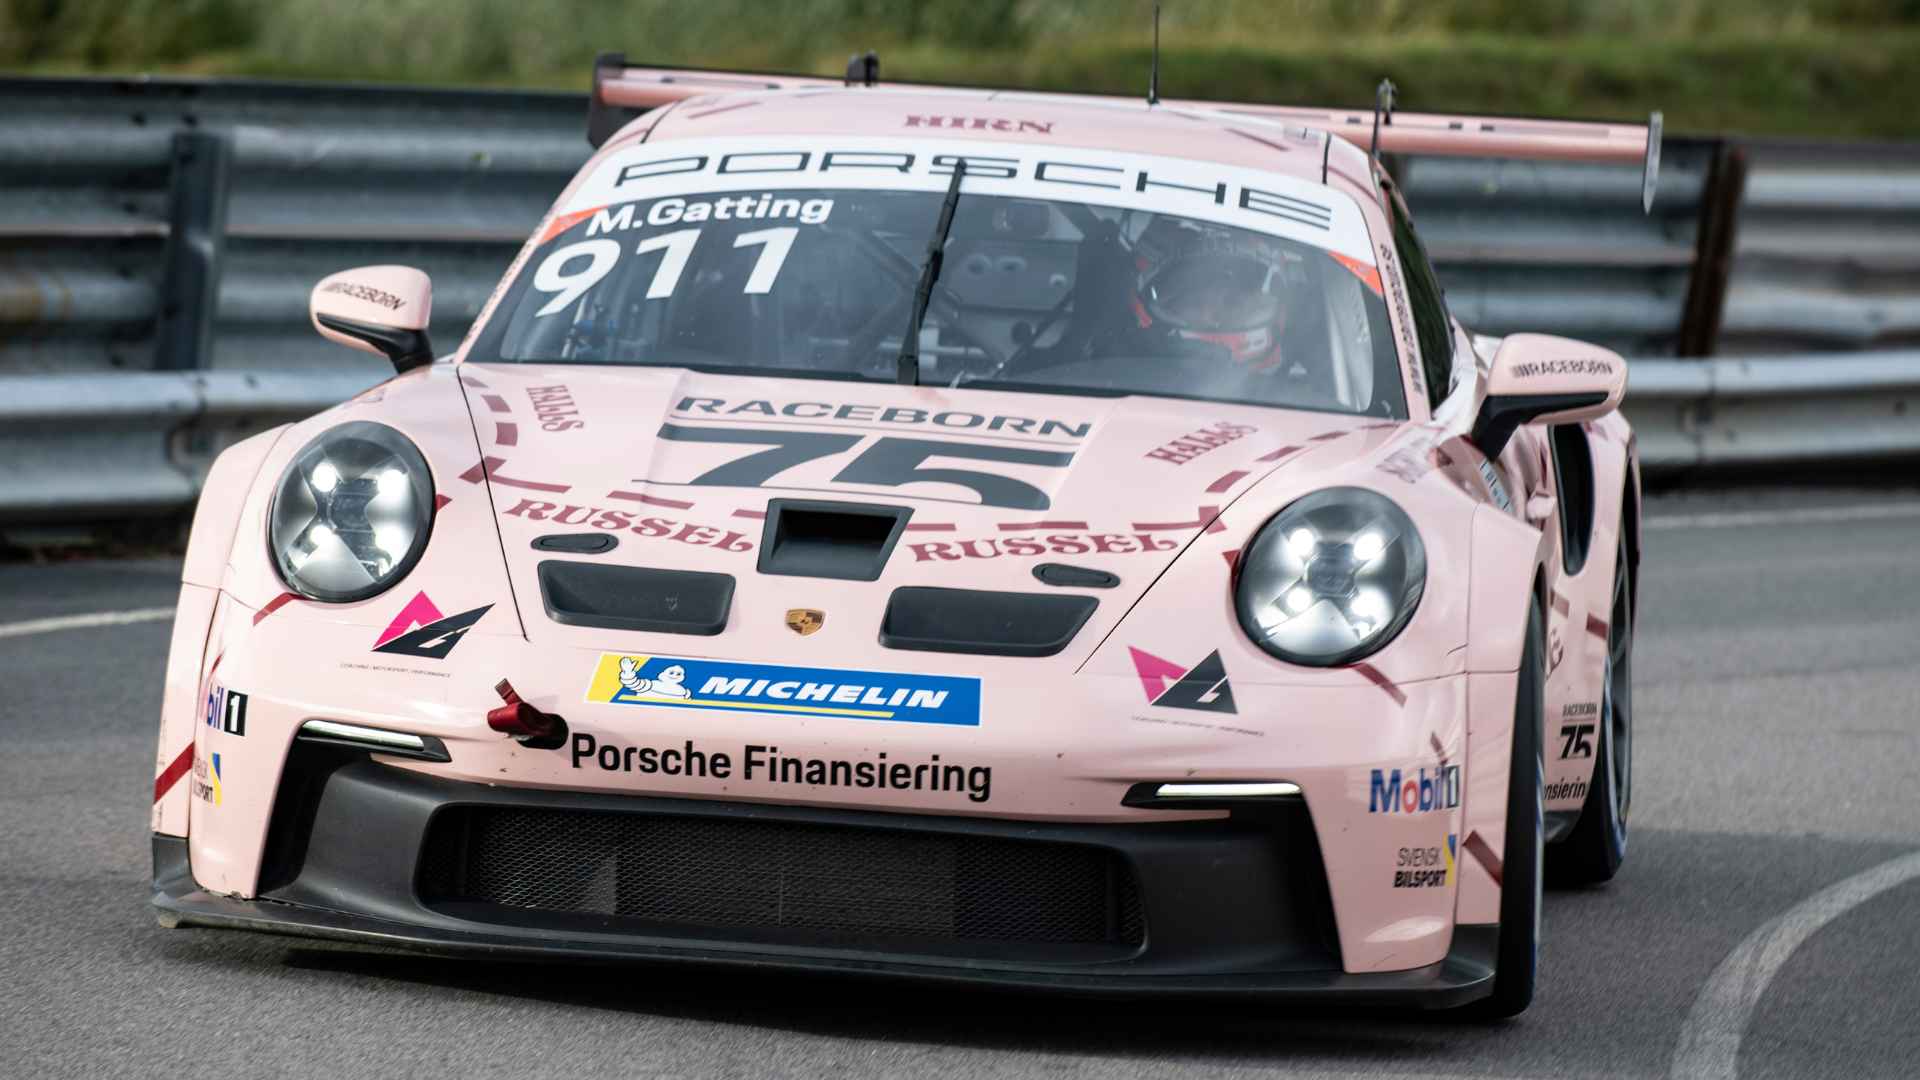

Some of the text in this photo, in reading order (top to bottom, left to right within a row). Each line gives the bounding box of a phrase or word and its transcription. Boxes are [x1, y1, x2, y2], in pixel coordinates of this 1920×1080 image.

[905, 115, 1054, 134] HIRN
[614, 151, 1332, 230] PORSCHE
[585, 192, 834, 237] M.Gatting
[533, 226, 799, 318] 911
[676, 396, 1092, 438] RACEBORN
[656, 421, 1078, 512] 75
[503, 498, 754, 553] RUSSEL
[906, 532, 1179, 563] RUSSEL
[698, 675, 950, 710] MICHELIN
[1560, 724, 1595, 760] 75
[570, 732, 993, 803] Porsche Finansiering
[1543, 776, 1587, 801] nsierin
[1368, 766, 1443, 815] Mobil
[1391, 869, 1449, 888] BILSPORT
